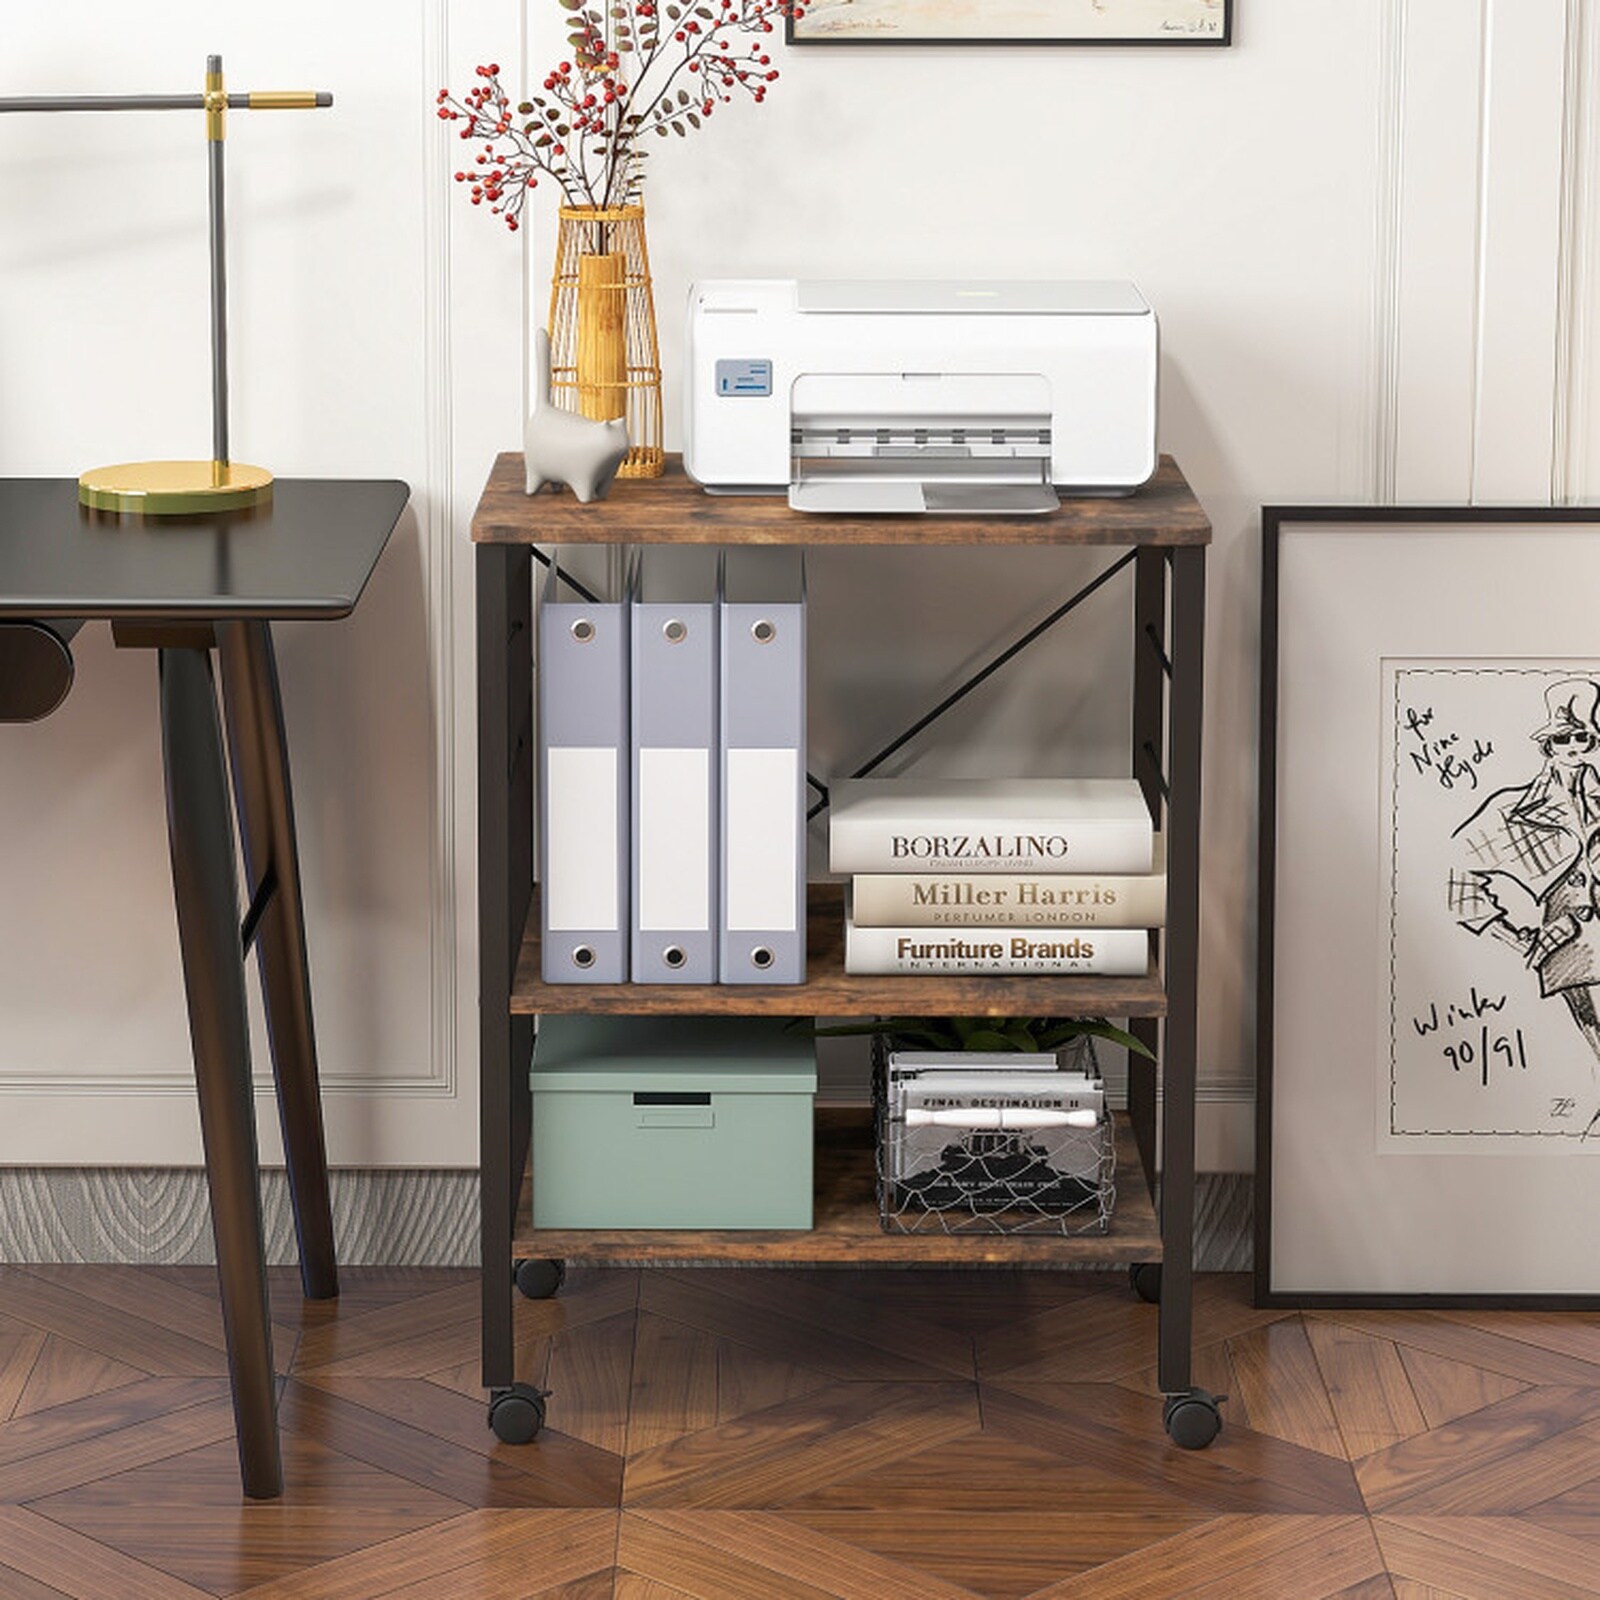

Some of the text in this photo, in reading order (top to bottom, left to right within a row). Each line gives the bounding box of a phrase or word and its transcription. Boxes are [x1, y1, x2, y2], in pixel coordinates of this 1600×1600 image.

[891, 836, 1068, 858] BORZALINO
[912, 882, 1117, 906] Miller Harris
[934, 912, 1097, 923] PERFUMER LONDON
[897, 937, 1094, 959] Furniture Brands
[1443, 1025, 1527, 1086] 90/91
[923, 1099, 963, 1107] FINAL
[970, 1099, 1062, 1108] DESTINATION
